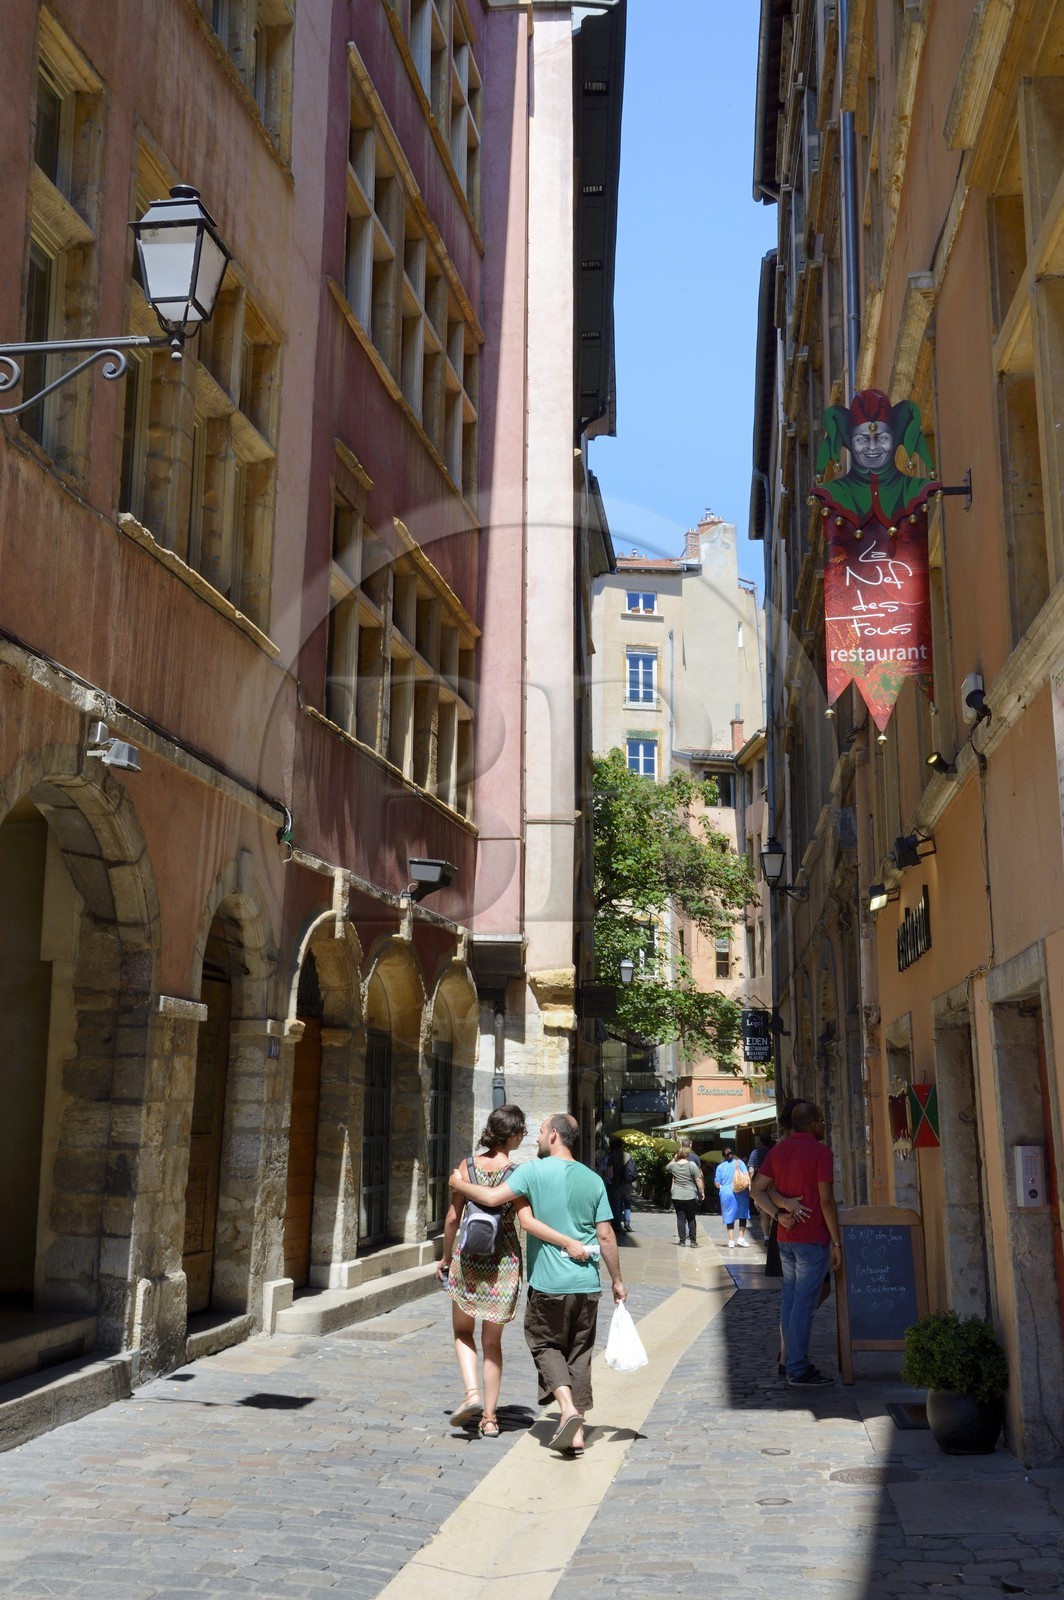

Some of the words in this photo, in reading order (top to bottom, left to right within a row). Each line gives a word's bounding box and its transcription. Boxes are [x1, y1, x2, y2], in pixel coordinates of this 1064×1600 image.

[859, 541, 892, 562] La
[845, 560, 913, 589] Nef
[852, 589, 899, 612] des
[831, 645, 927, 662] restaurant
[270, 1039, 279, 1057] 10
[746, 1037, 768, 1045] EDEN
[696, 1084, 744, 1096] Restaurant
[856, 1265, 891, 1275] Restaurant
